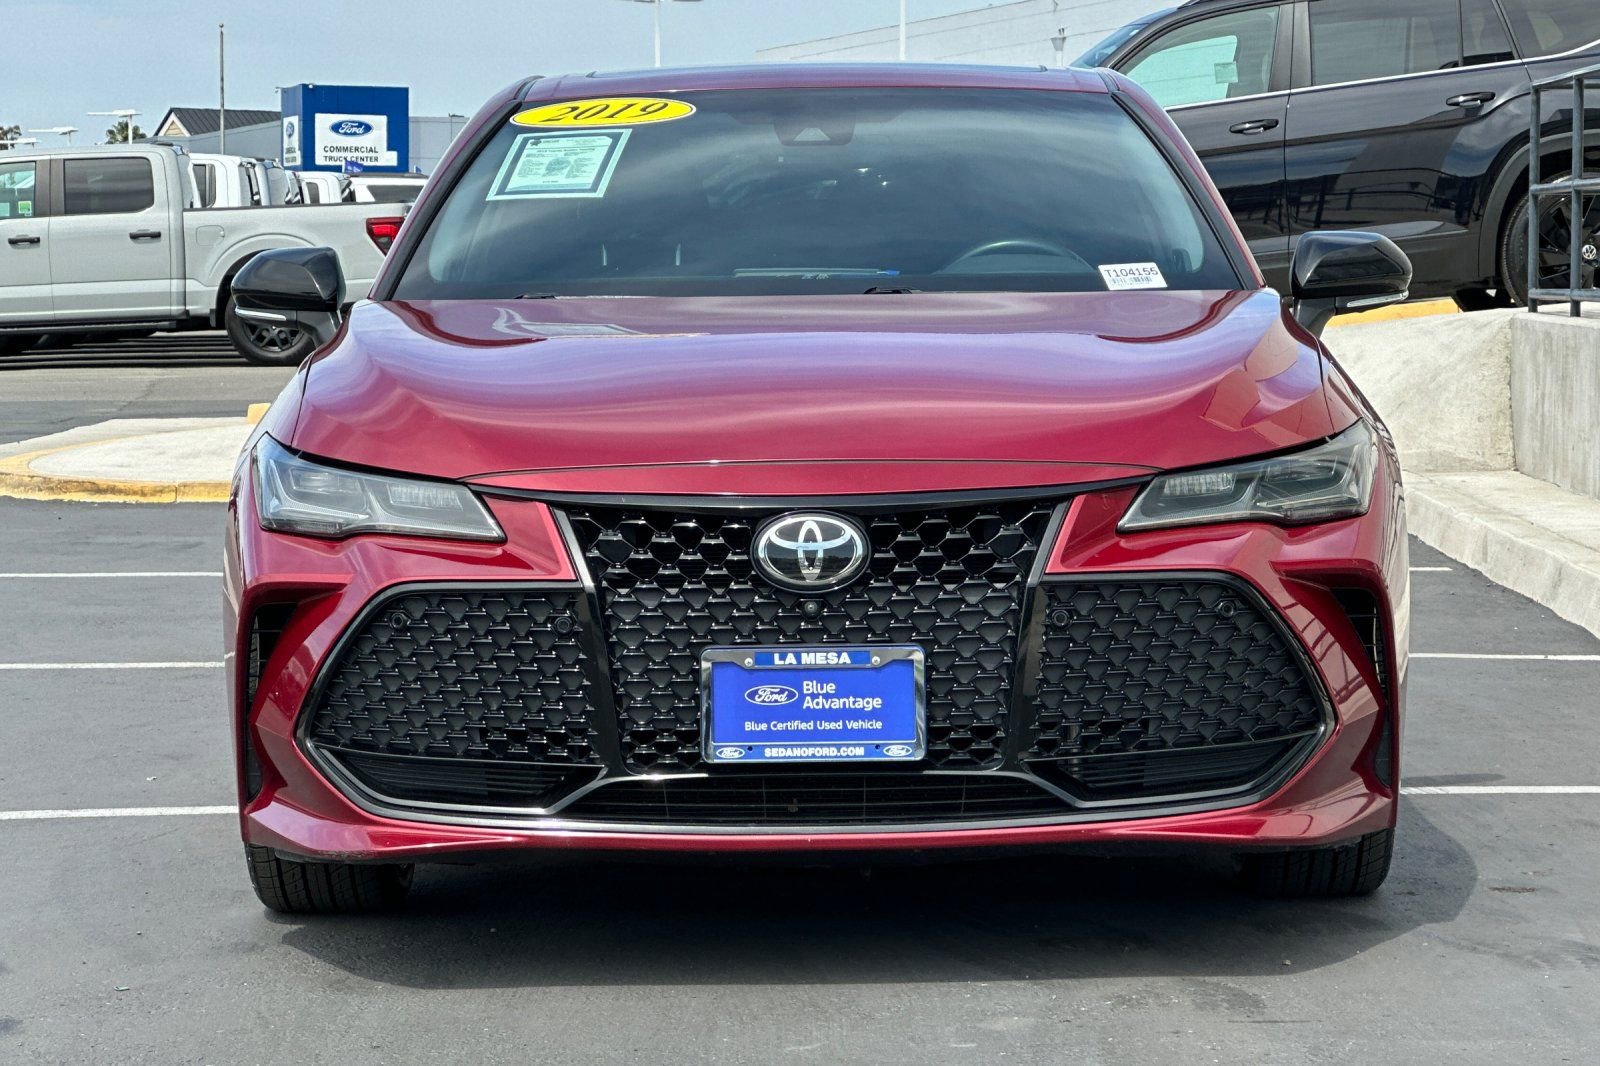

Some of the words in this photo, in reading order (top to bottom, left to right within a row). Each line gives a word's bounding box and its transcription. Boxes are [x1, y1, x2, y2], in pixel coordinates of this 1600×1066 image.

[538, 102, 669, 123] 2019
[339, 121, 365, 134] Ford
[323, 145, 379, 154] COMMERCIAL
[350, 155, 379, 163] CENTER
[1103, 266, 1159, 278] T104155
[773, 652, 798, 665] LA
[801, 651, 852, 665] MESA
[803, 680, 836, 694] Blue
[754, 687, 789, 702] Ford
[802, 695, 883, 711] Advantage
[744, 721, 768, 731] Blue
[770, 720, 814, 731] Certified
[816, 719, 843, 730] Used
[845, 719, 883, 730] Vehicle
[763, 746, 865, 758] SEDANOFORD.COM
